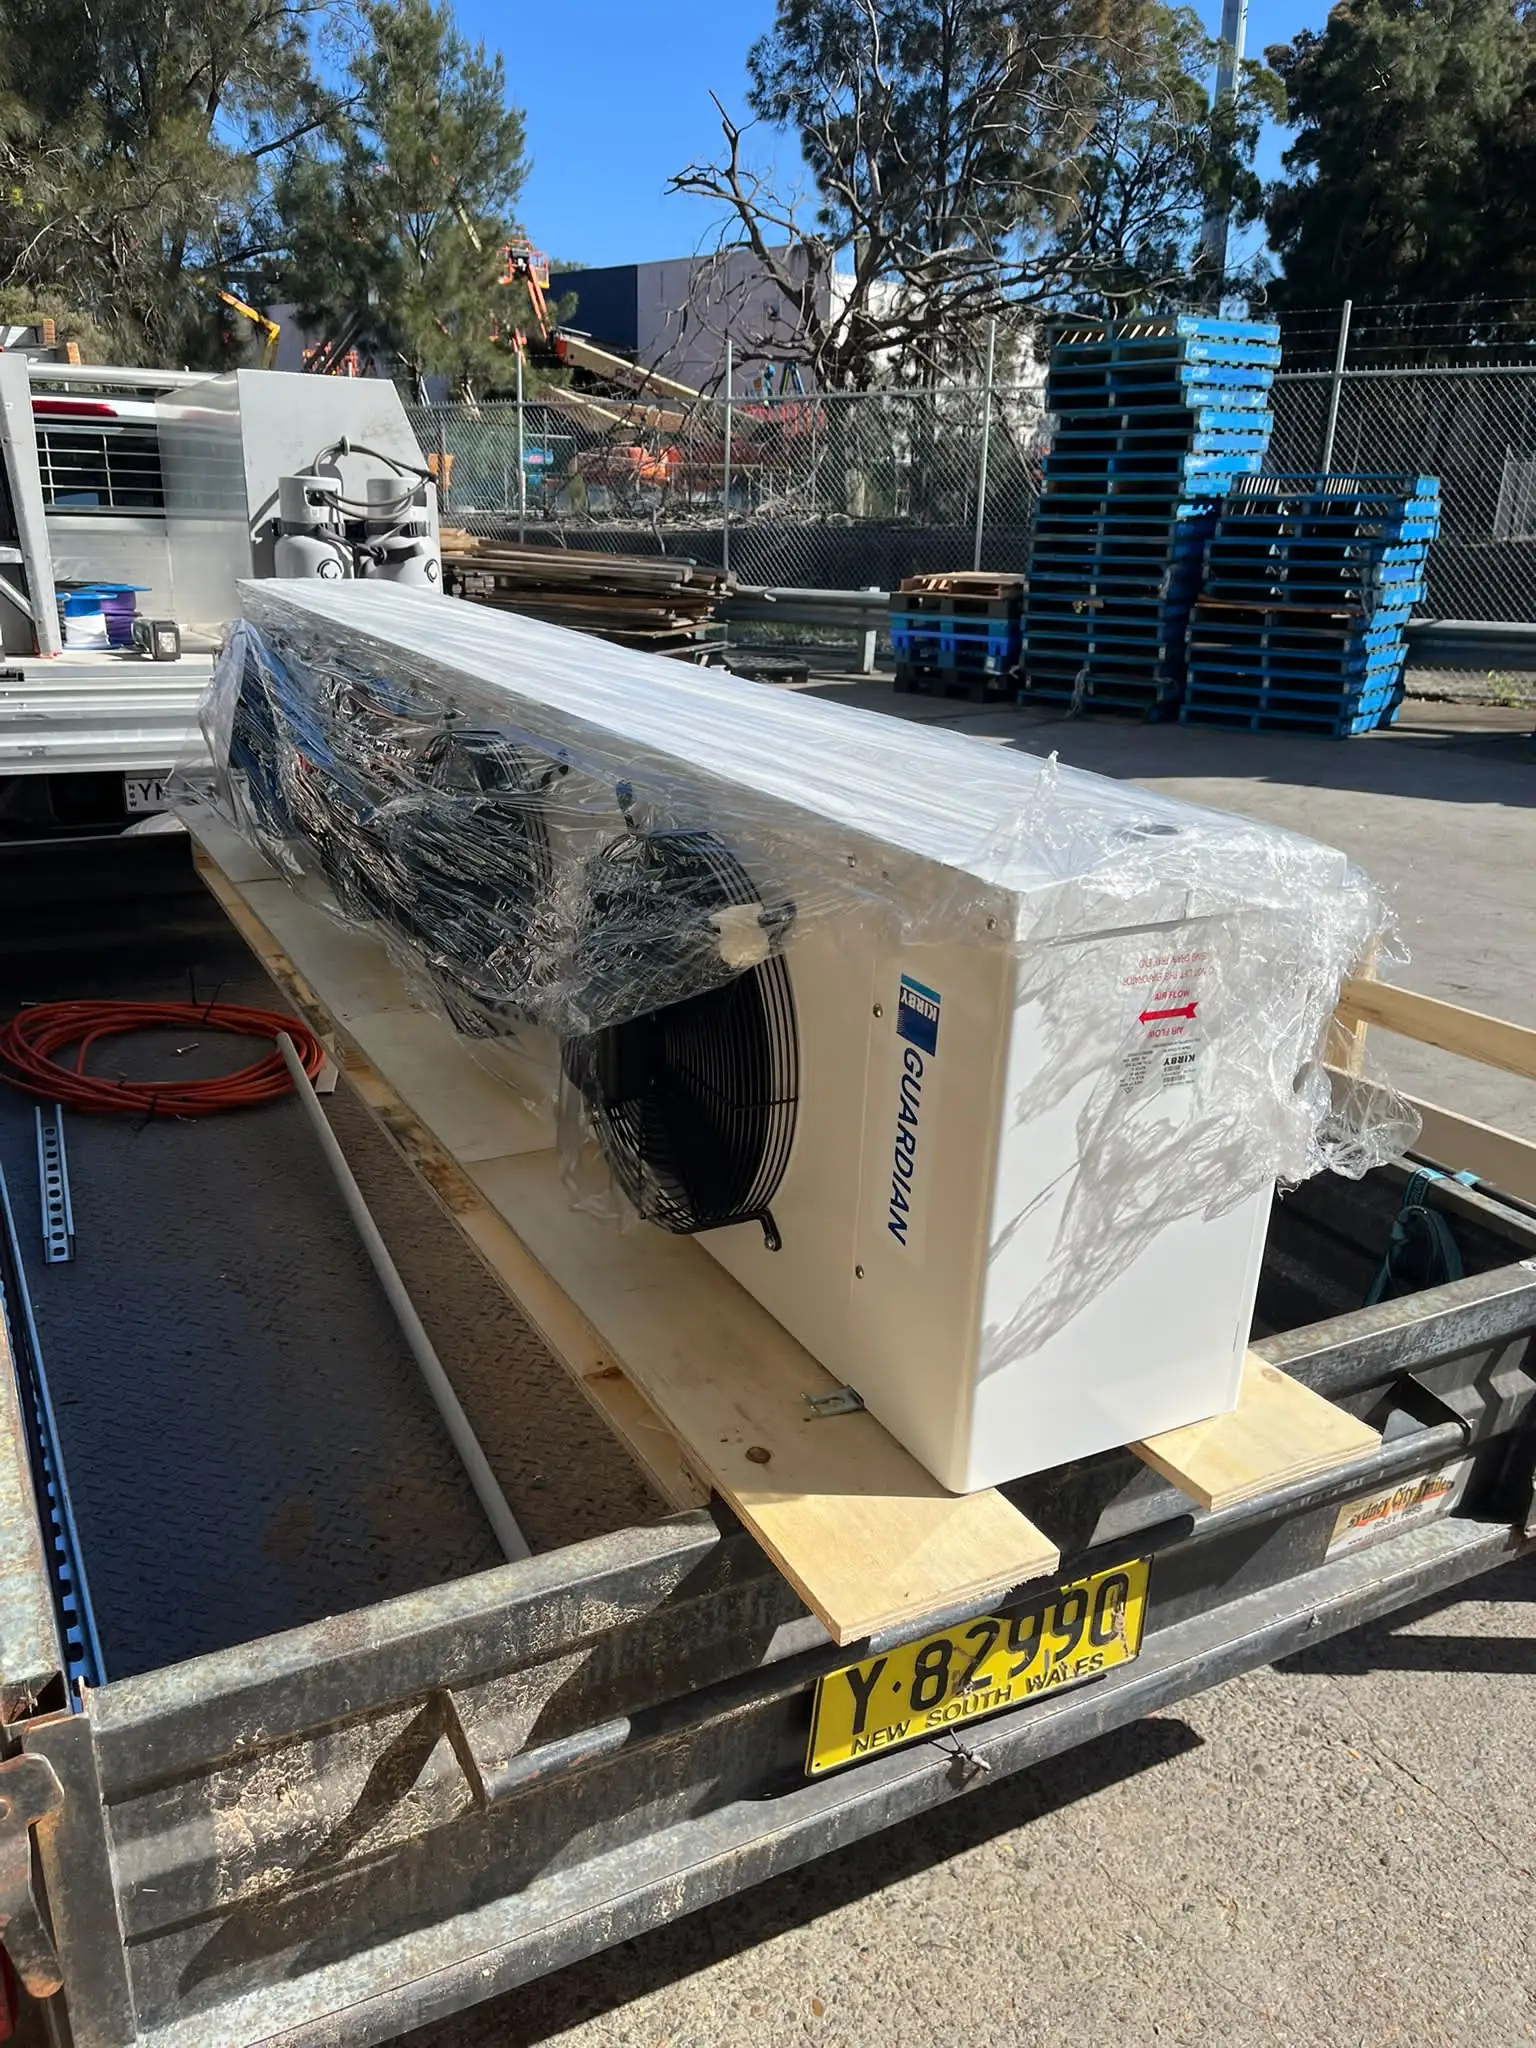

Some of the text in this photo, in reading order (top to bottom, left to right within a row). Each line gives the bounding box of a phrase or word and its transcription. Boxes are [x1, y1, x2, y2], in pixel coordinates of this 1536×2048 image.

[901, 989, 938, 1022] KIRBY
[1154, 989, 1190, 1001] AIR FLOW
[1147, 1026, 1185, 1039] AIR FLOW
[1163, 1053, 1196, 1067] KIRBY
[888, 1047, 924, 1247] GUARDIAN
[851, 1652, 1104, 1756] NEW SOUTH WALES
